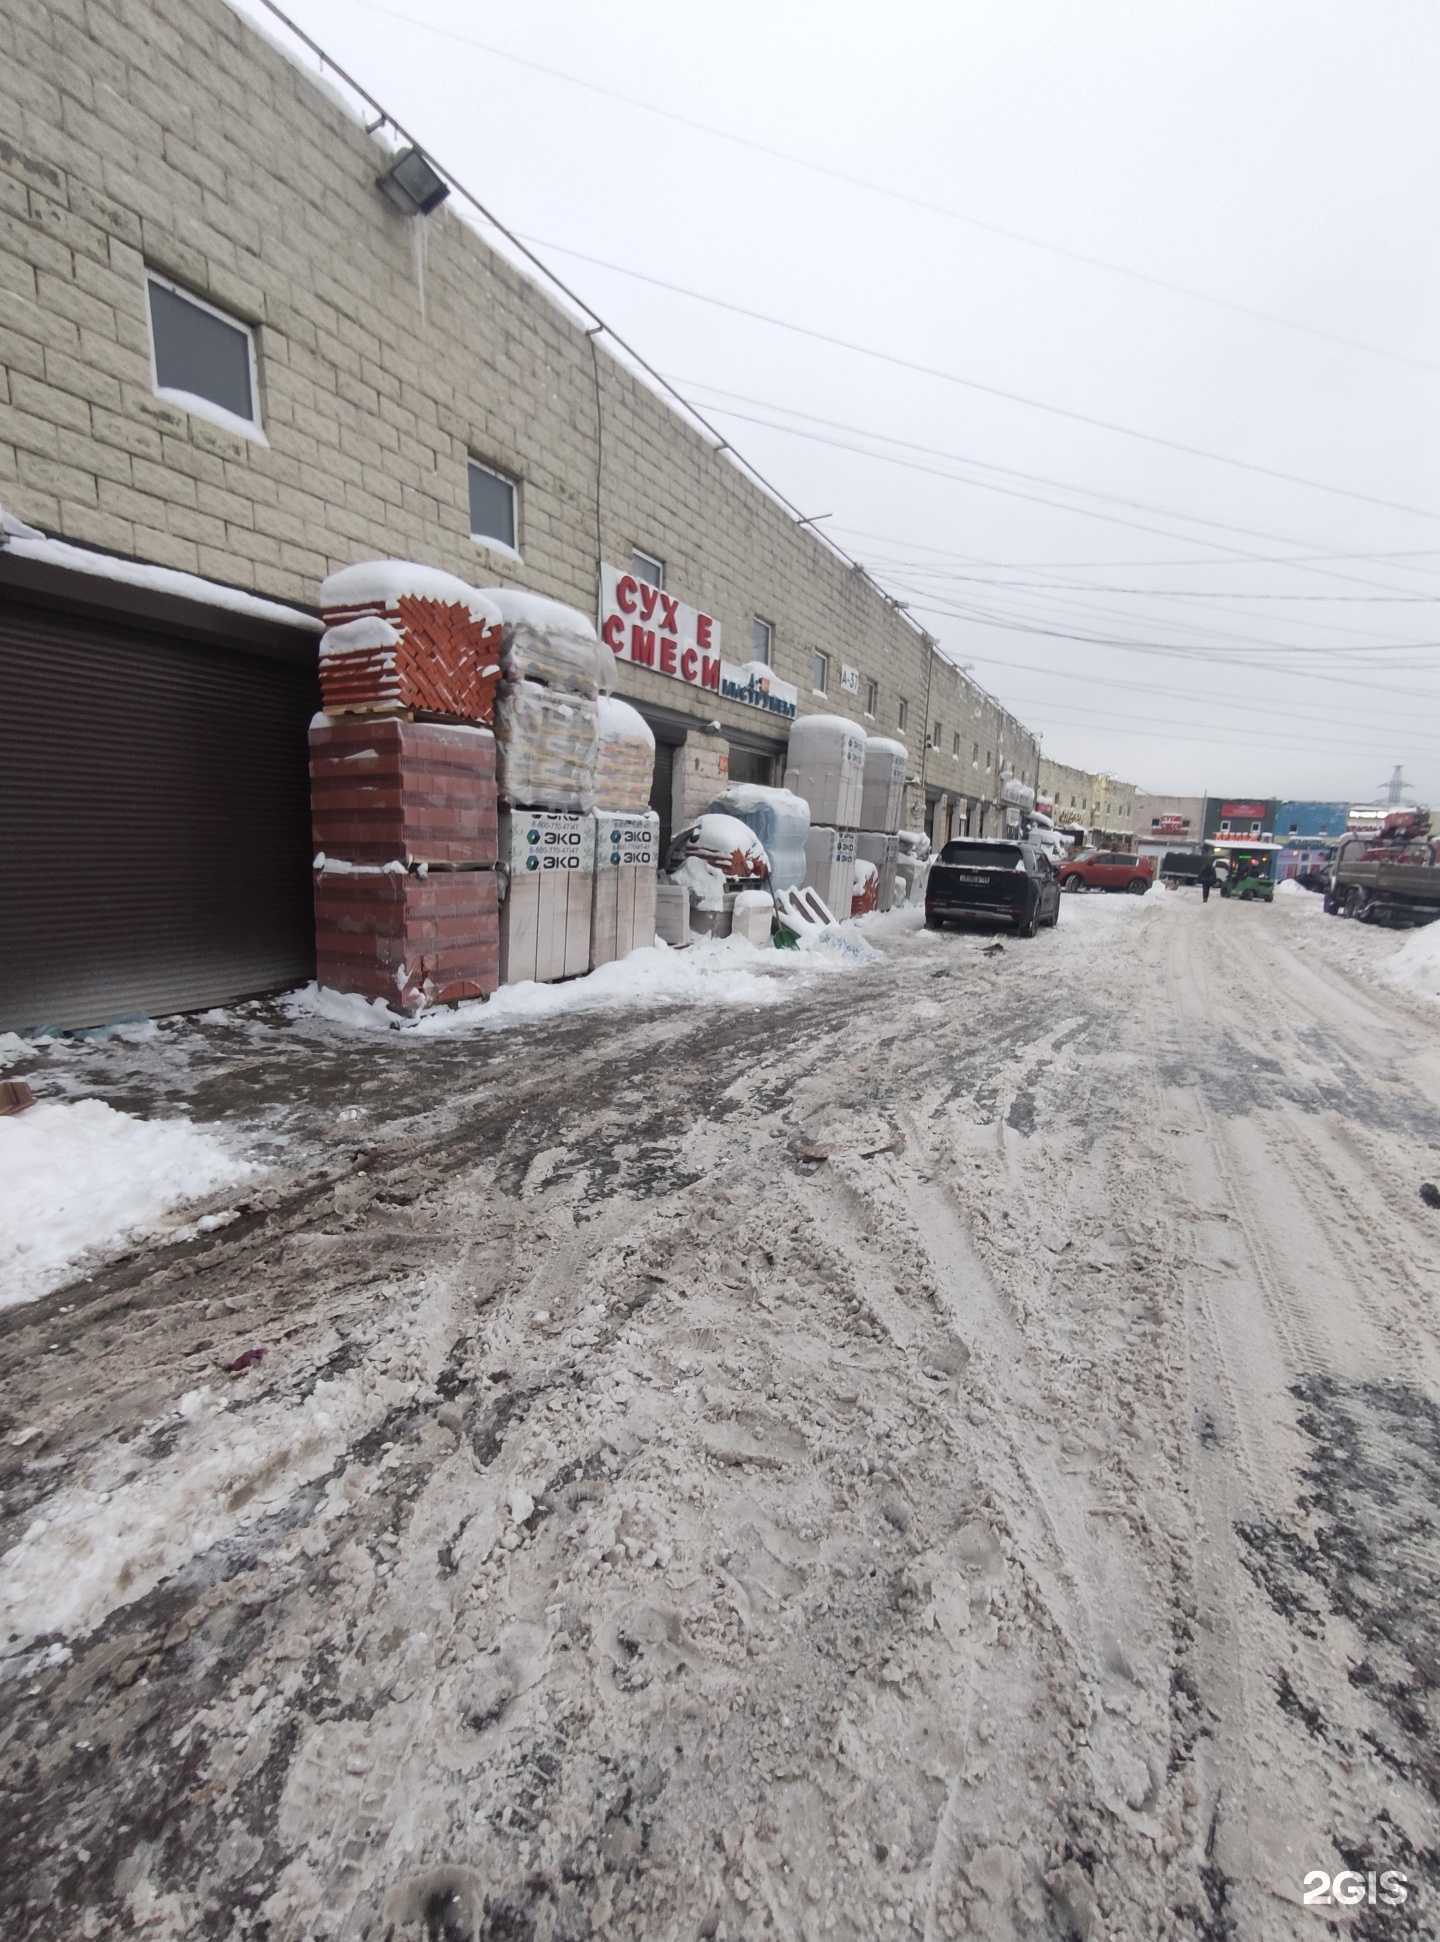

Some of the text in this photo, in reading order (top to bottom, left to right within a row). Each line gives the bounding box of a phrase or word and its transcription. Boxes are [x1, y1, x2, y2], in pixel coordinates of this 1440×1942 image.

[602, 614, 722, 690] СМЕСИ
[545, 832, 581, 845] ЭКО
[625, 831, 652, 843] ЭКО
[543, 856, 580, 869] ЭКО
[624, 852, 651, 863] ЭКО
